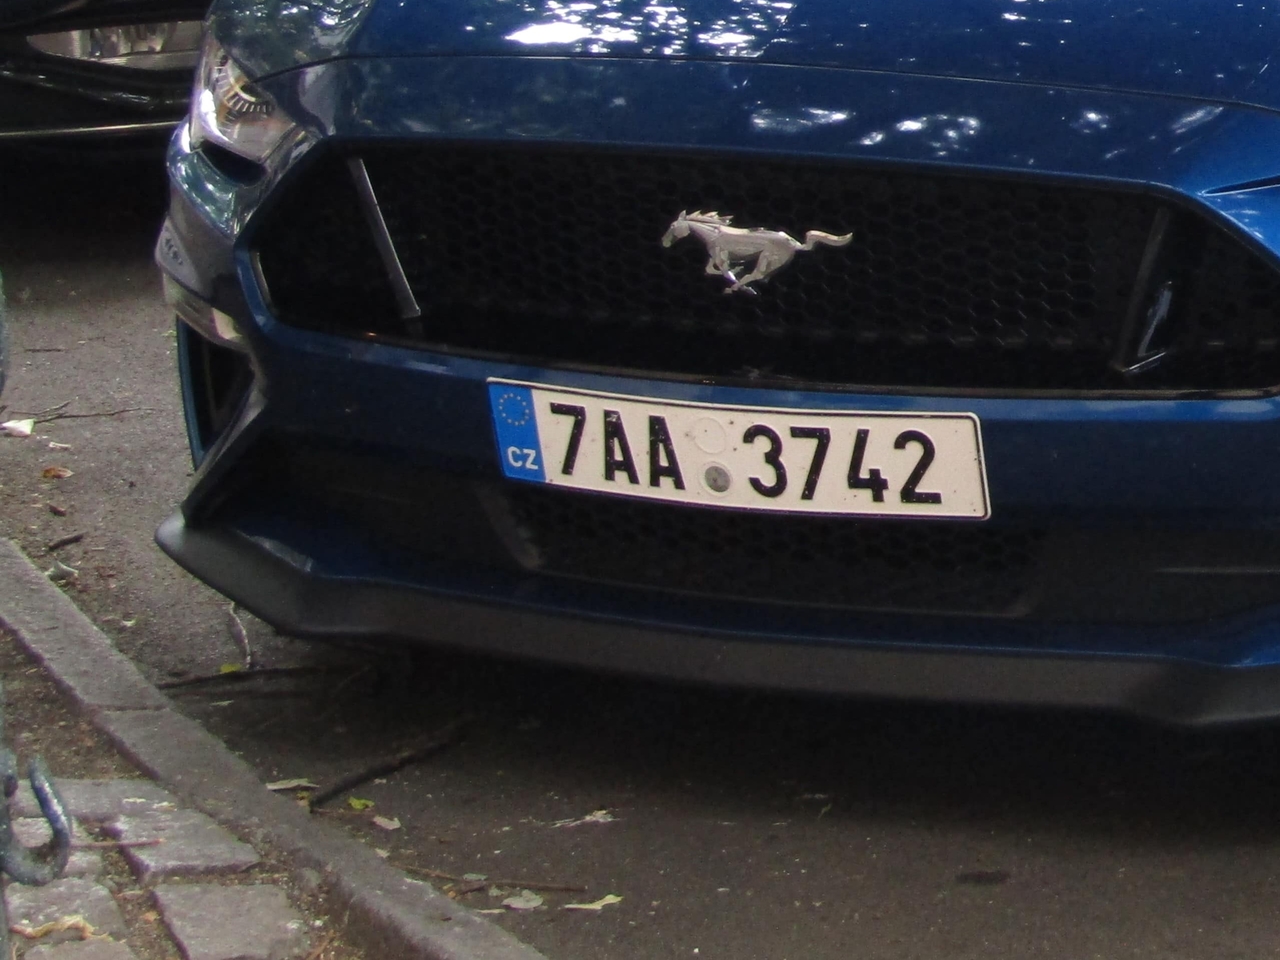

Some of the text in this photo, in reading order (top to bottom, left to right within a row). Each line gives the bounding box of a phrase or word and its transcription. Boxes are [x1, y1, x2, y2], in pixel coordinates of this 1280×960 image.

[508, 446, 539, 470] CZ
[550, 403, 942, 504] 7AA 3742
